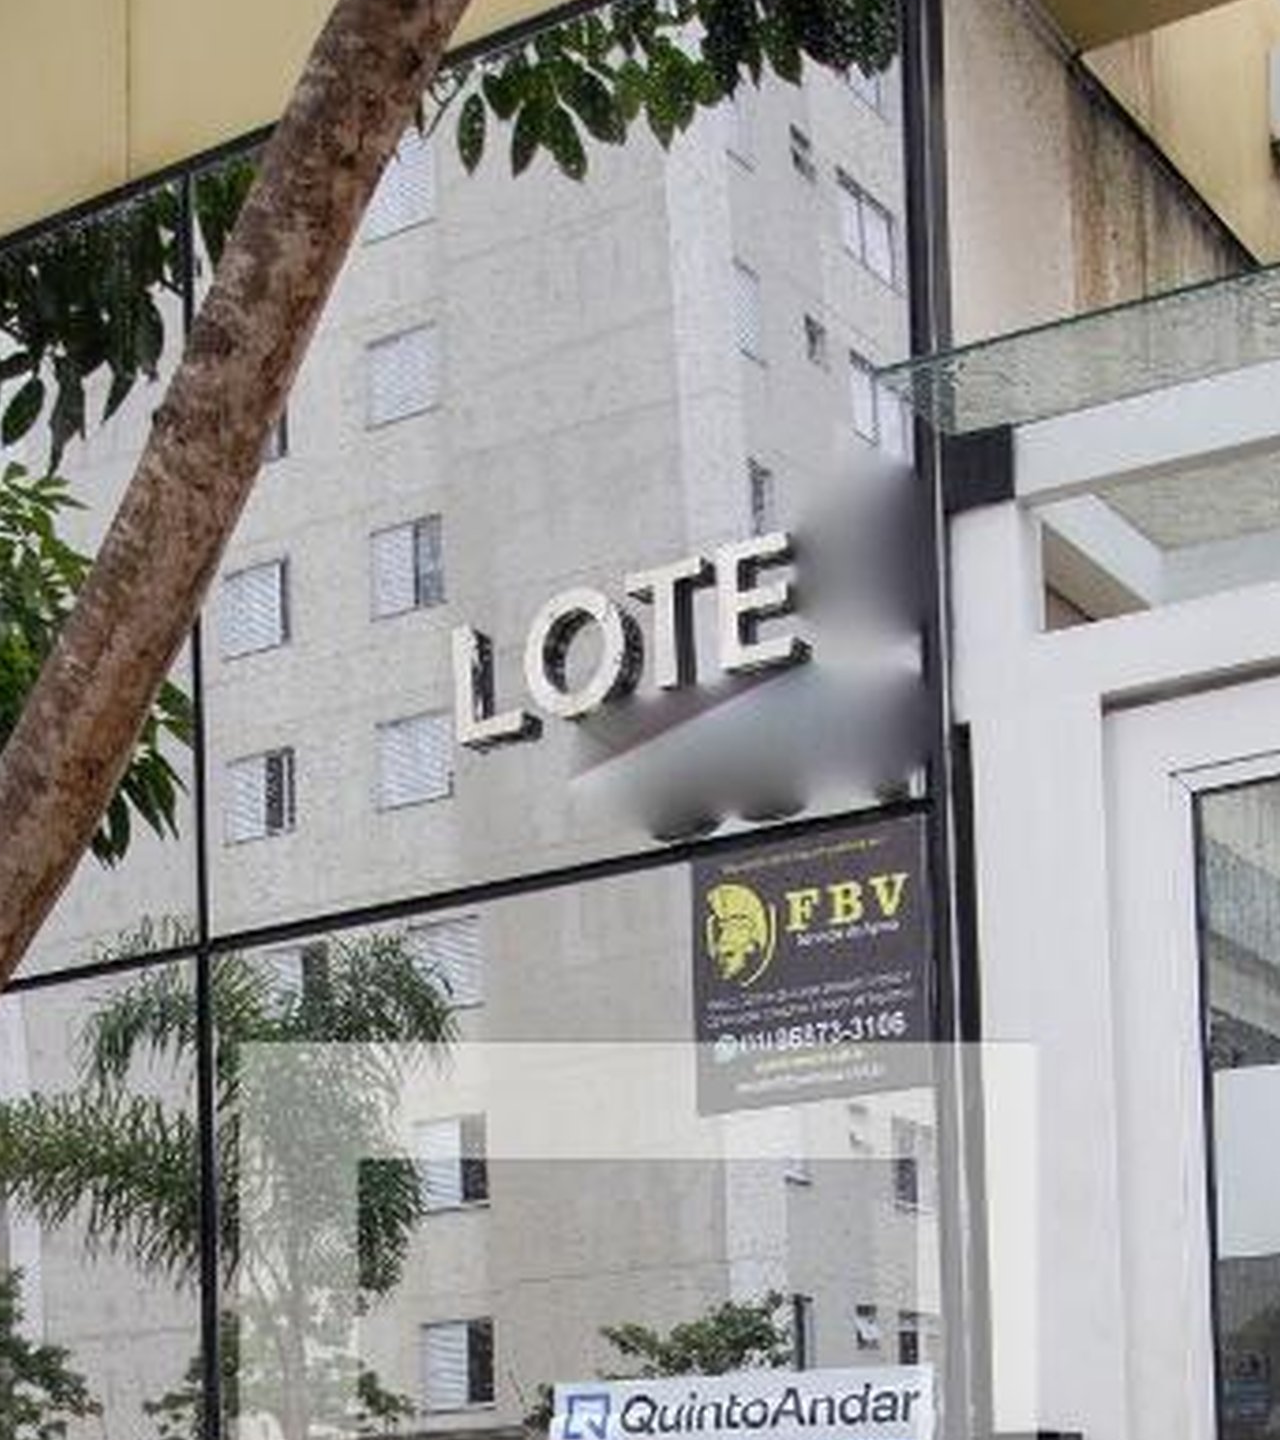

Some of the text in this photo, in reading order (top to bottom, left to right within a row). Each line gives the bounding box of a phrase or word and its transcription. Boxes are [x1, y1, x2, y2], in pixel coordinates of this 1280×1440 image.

[451, 531, 810, 750] LOTE
[786, 872, 910, 932] FBV
[620, 1383, 918, 1435] QuintoAndar
